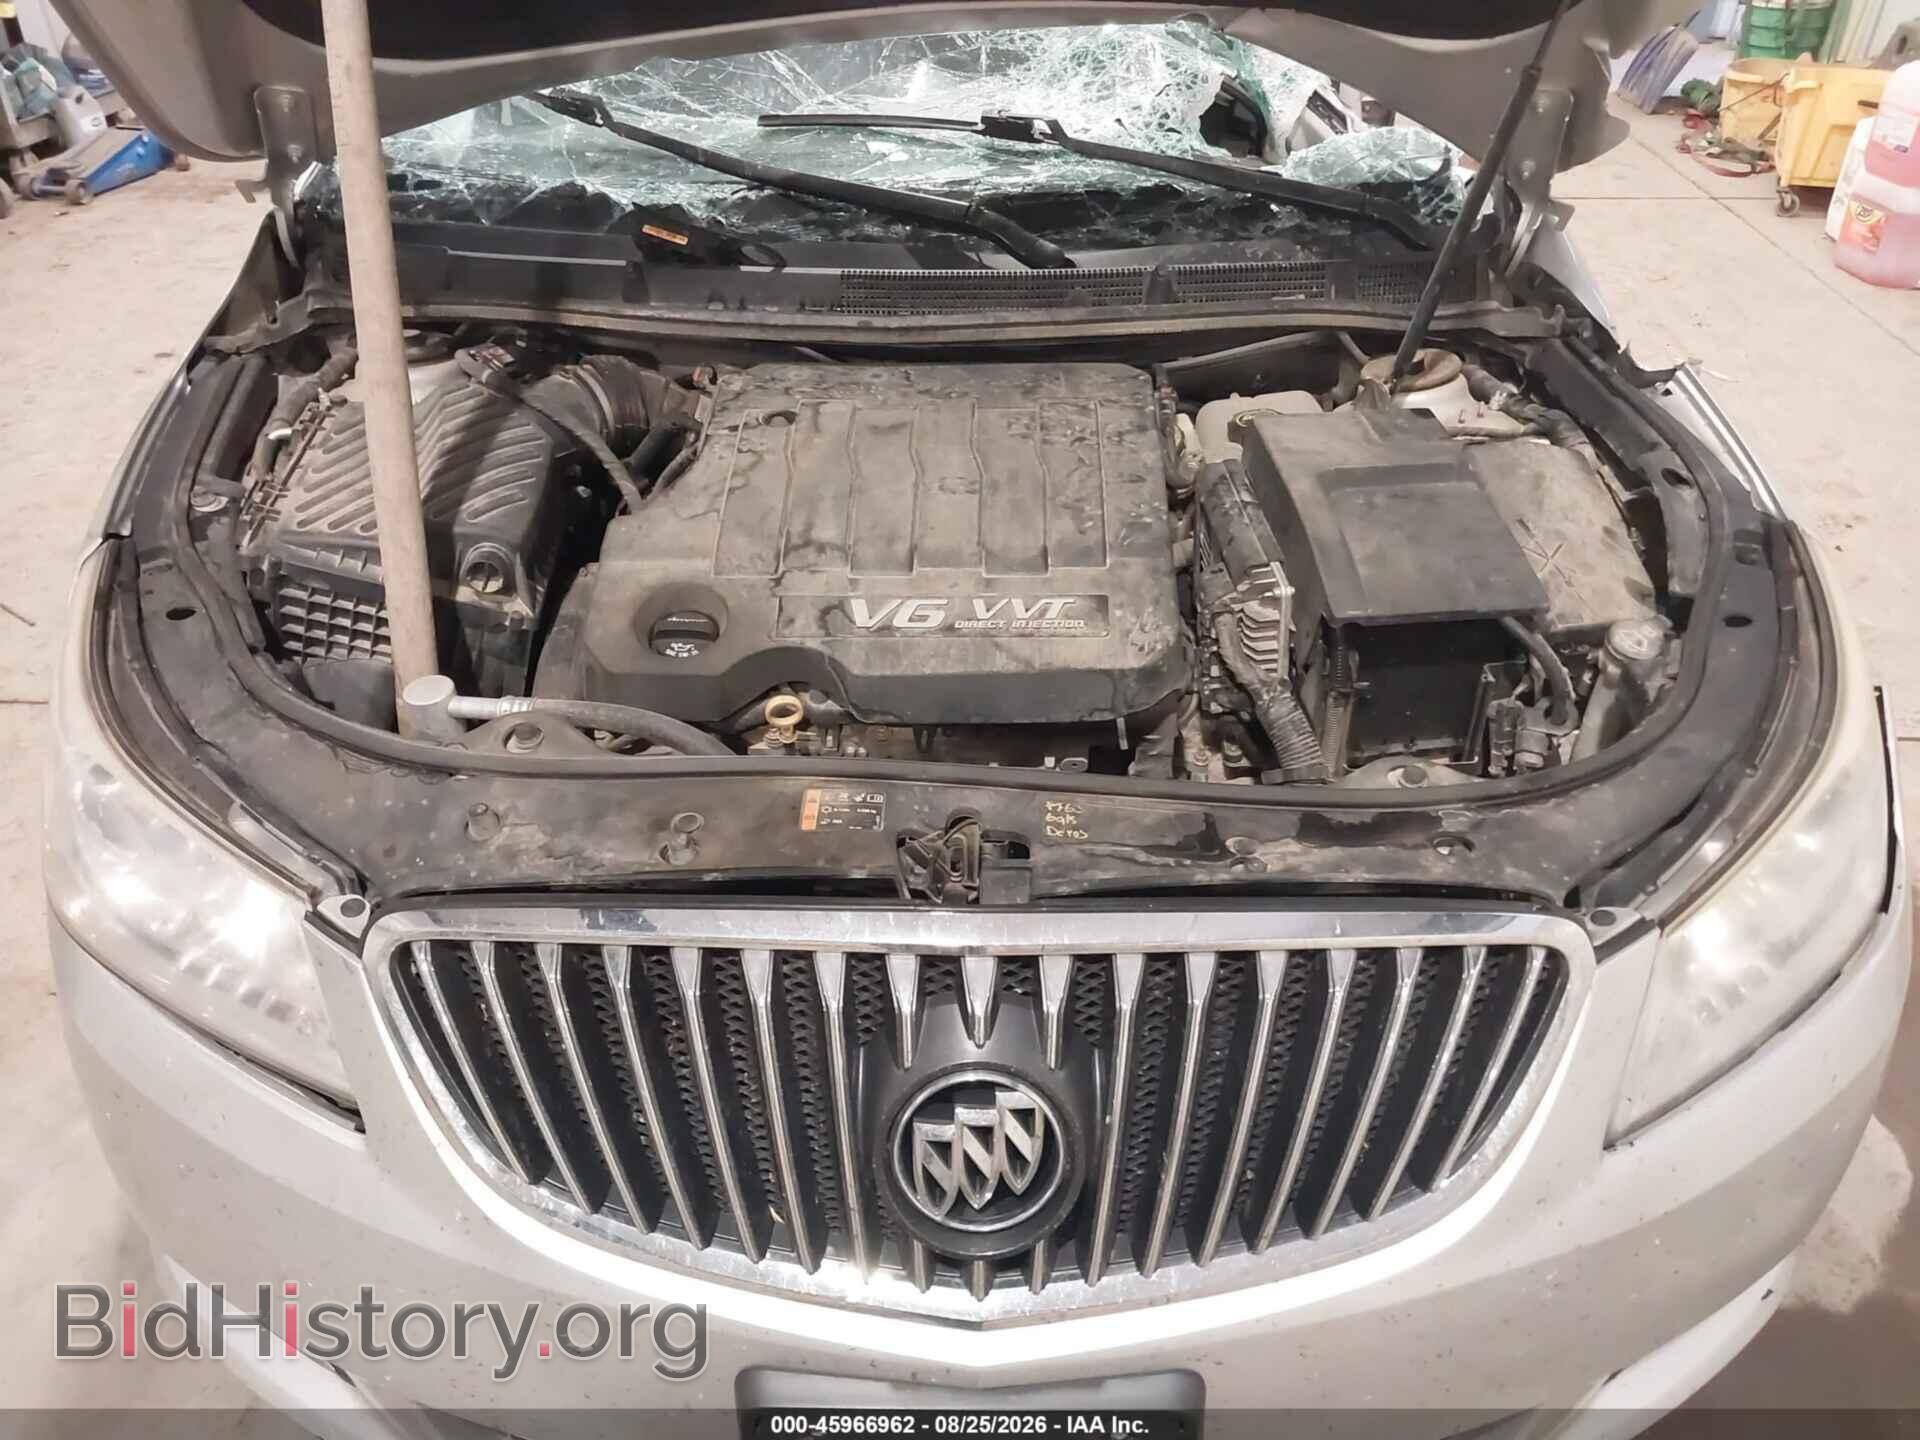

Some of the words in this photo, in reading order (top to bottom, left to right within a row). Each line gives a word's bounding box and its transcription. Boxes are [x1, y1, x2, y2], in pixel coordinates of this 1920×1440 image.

[851, 598, 948, 629] V6
[971, 598, 1077, 620] VVT
[955, 620, 1006, 630] DIRECT
[1012, 620, 1086, 630] INJECTION
